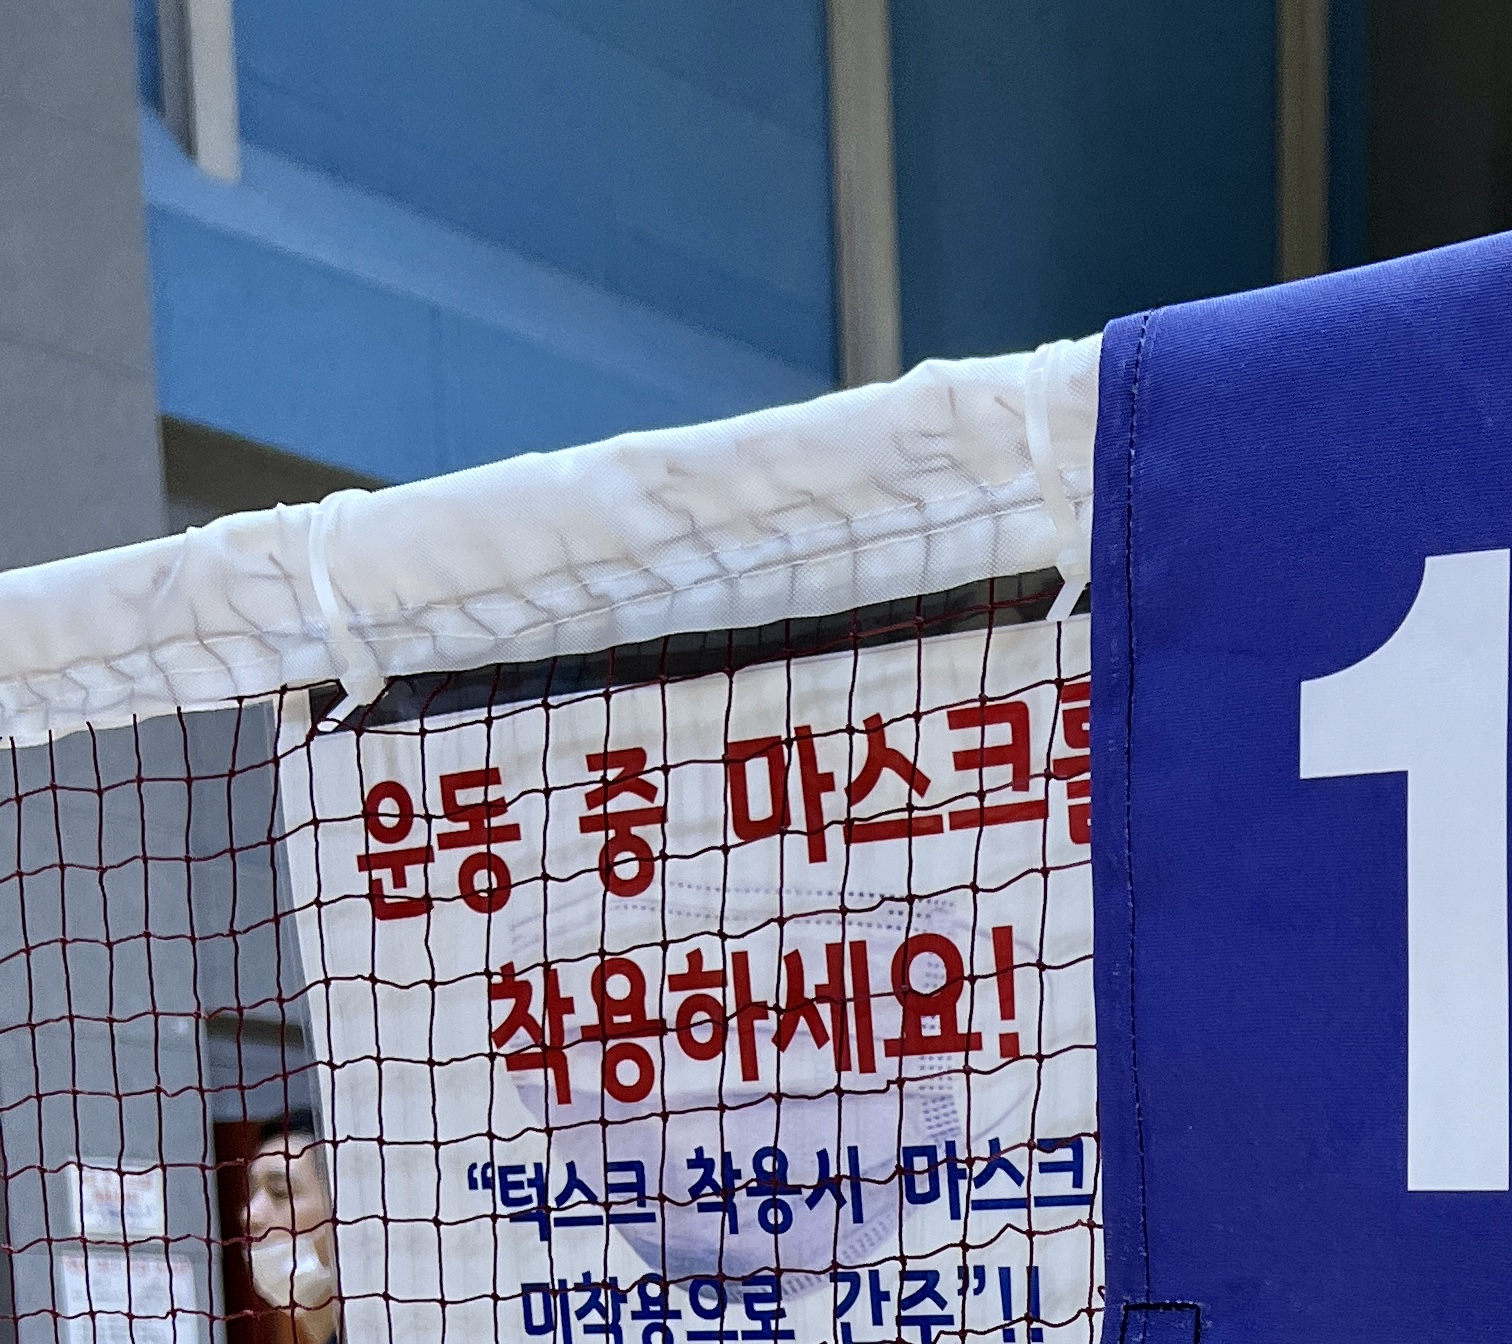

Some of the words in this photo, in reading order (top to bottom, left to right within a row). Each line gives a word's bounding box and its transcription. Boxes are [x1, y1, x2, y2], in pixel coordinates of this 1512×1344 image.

[356, 768, 523, 920] 운동
[577, 747, 667, 897] 중
[1300, 548, 1511, 1191] 1
[490, 926, 1021, 1106] 착용하세요!
[687, 1144, 864, 1235] 착용시
[902, 1137, 1094, 1221] 마스크
